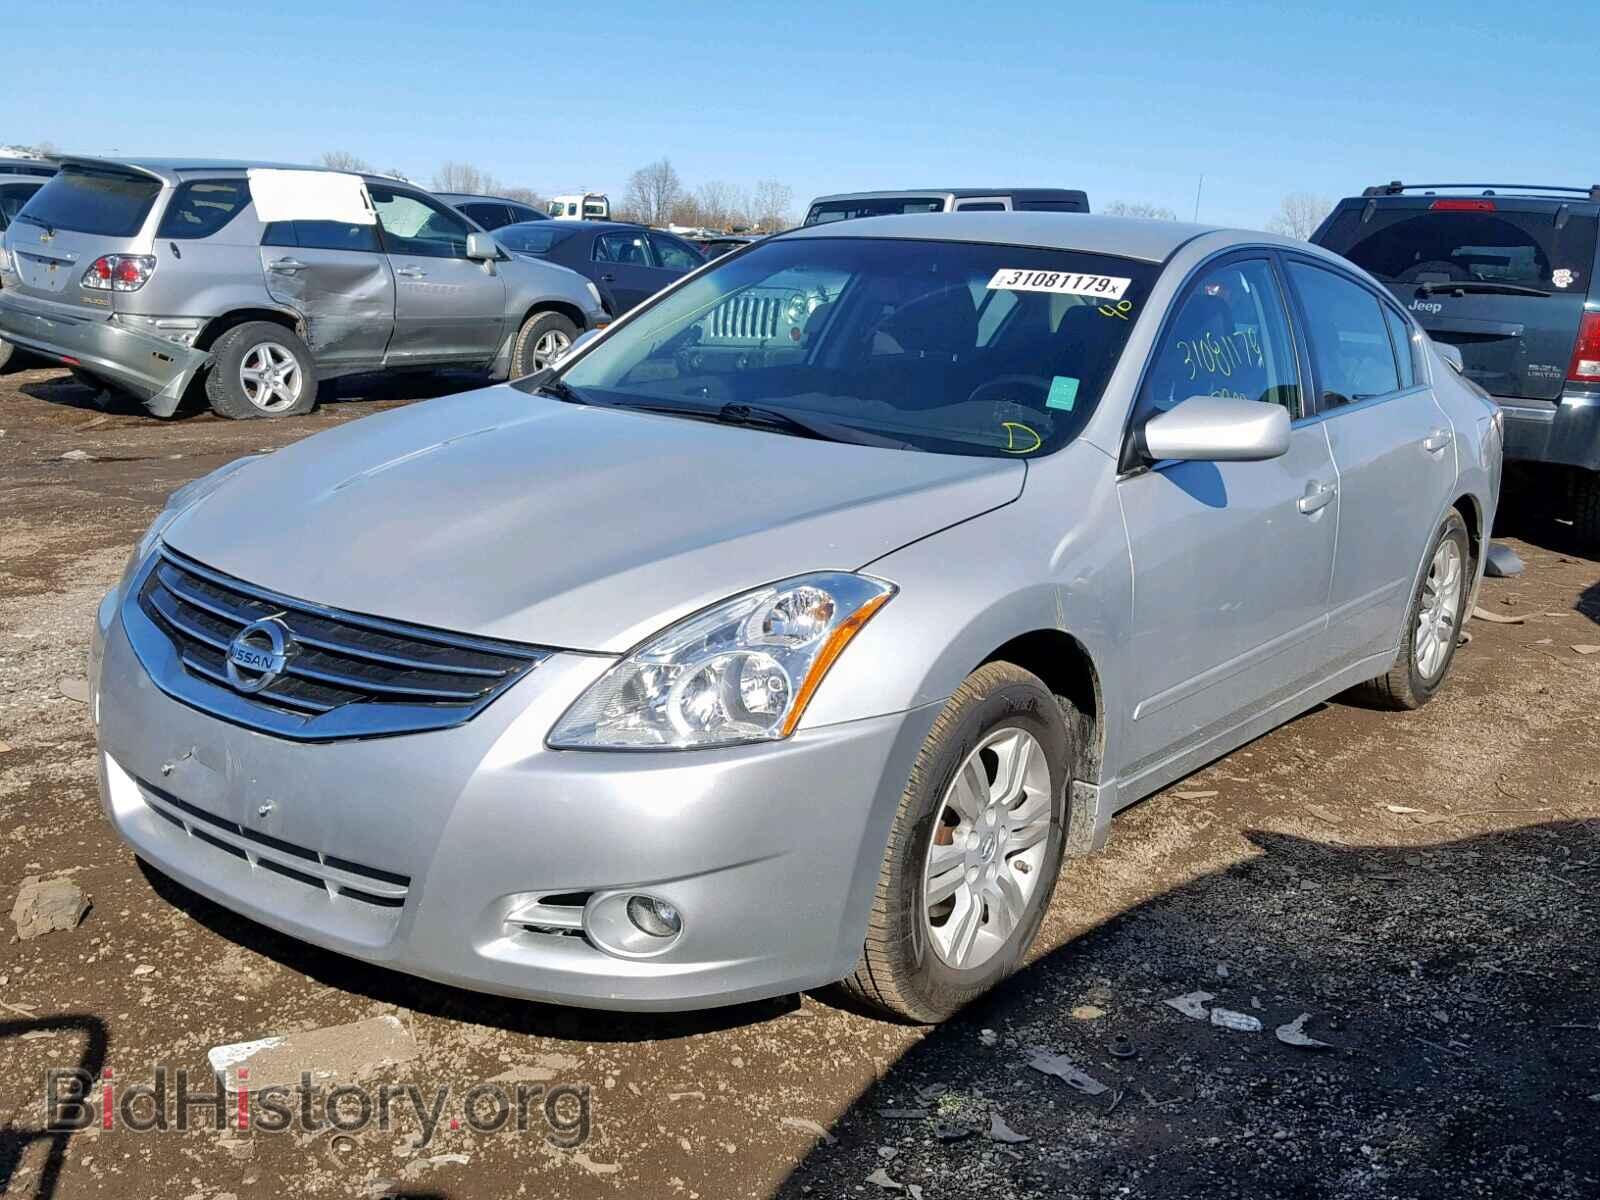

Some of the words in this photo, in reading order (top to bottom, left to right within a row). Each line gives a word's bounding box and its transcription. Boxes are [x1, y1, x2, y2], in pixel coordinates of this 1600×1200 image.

[1408, 299, 1442, 314] Jeep
[999, 422, 1042, 453] D
[229, 643, 274, 669] NISSAN
